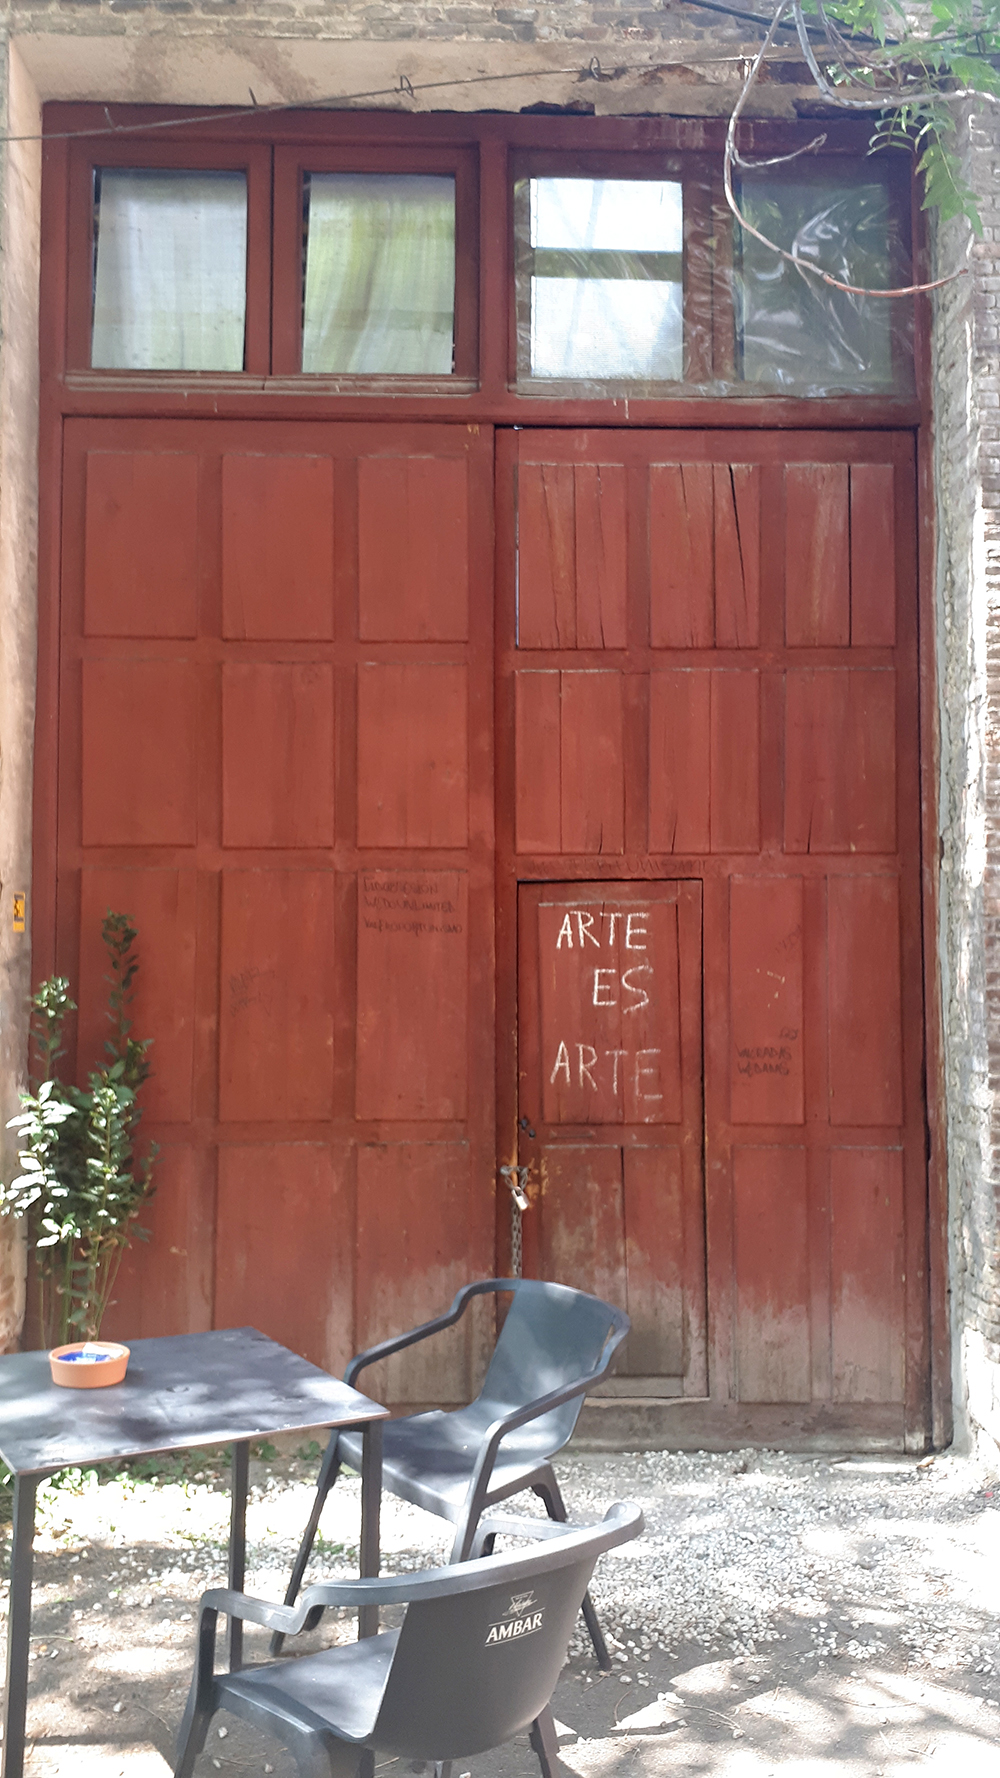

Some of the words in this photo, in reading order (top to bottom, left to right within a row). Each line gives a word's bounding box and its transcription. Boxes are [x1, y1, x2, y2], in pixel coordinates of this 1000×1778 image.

[556, 910, 650, 949] ARTE
[592, 964, 654, 1014] ES
[550, 1040, 664, 1100] ARTE
[485, 1613, 543, 1644] AMBAR
